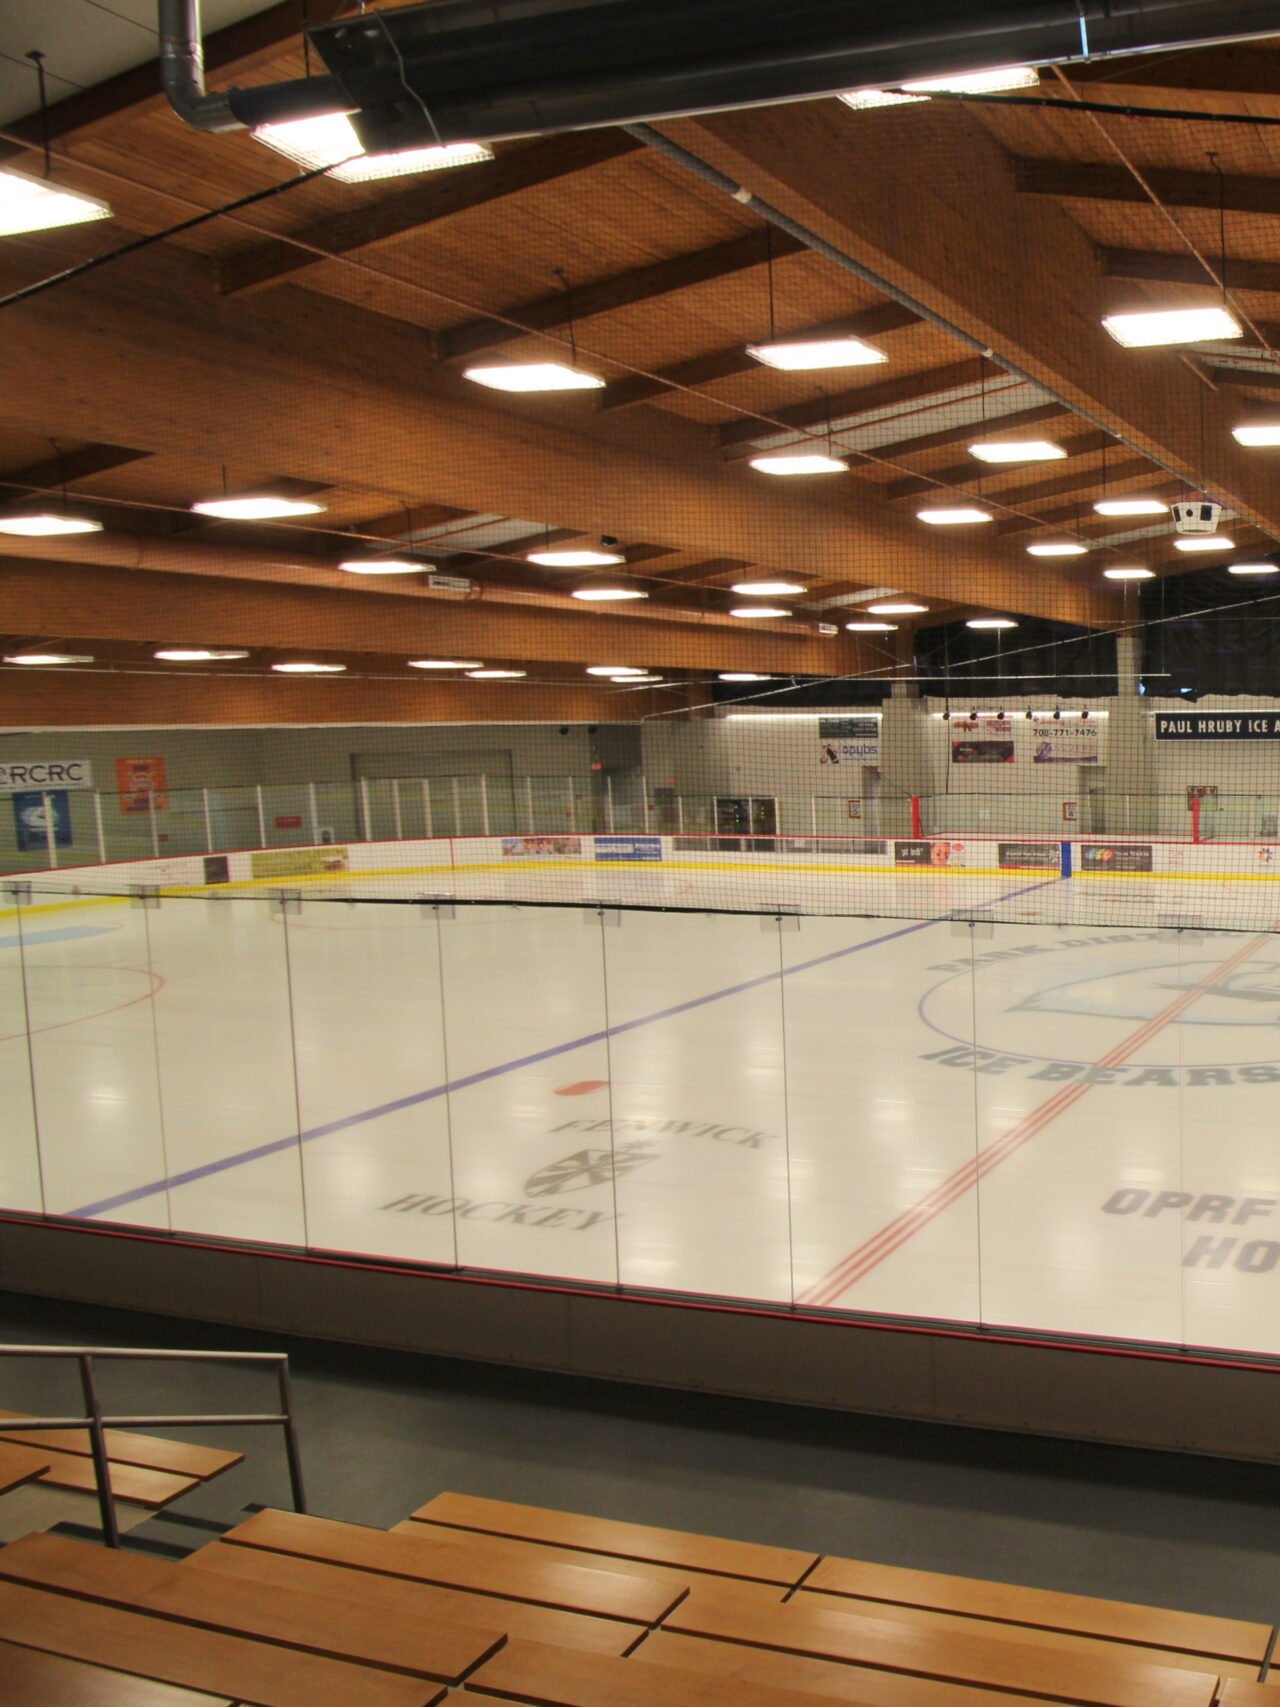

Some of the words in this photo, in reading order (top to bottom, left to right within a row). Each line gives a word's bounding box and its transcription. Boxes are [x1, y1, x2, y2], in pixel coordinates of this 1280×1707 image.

[1033, 728, 1097, 737] 708-771-7476
[1160, 720, 1193, 733] PAUL
[1198, 719, 1242, 733] HRUBY
[1248, 719, 1268, 733] ICE
[919, 1045, 1032, 1075] ICE
[550, 1119, 780, 1149] FENWICK
[380, 1193, 625, 1231] HOCKEY
[1101, 1187, 1278, 1226] OPRF
